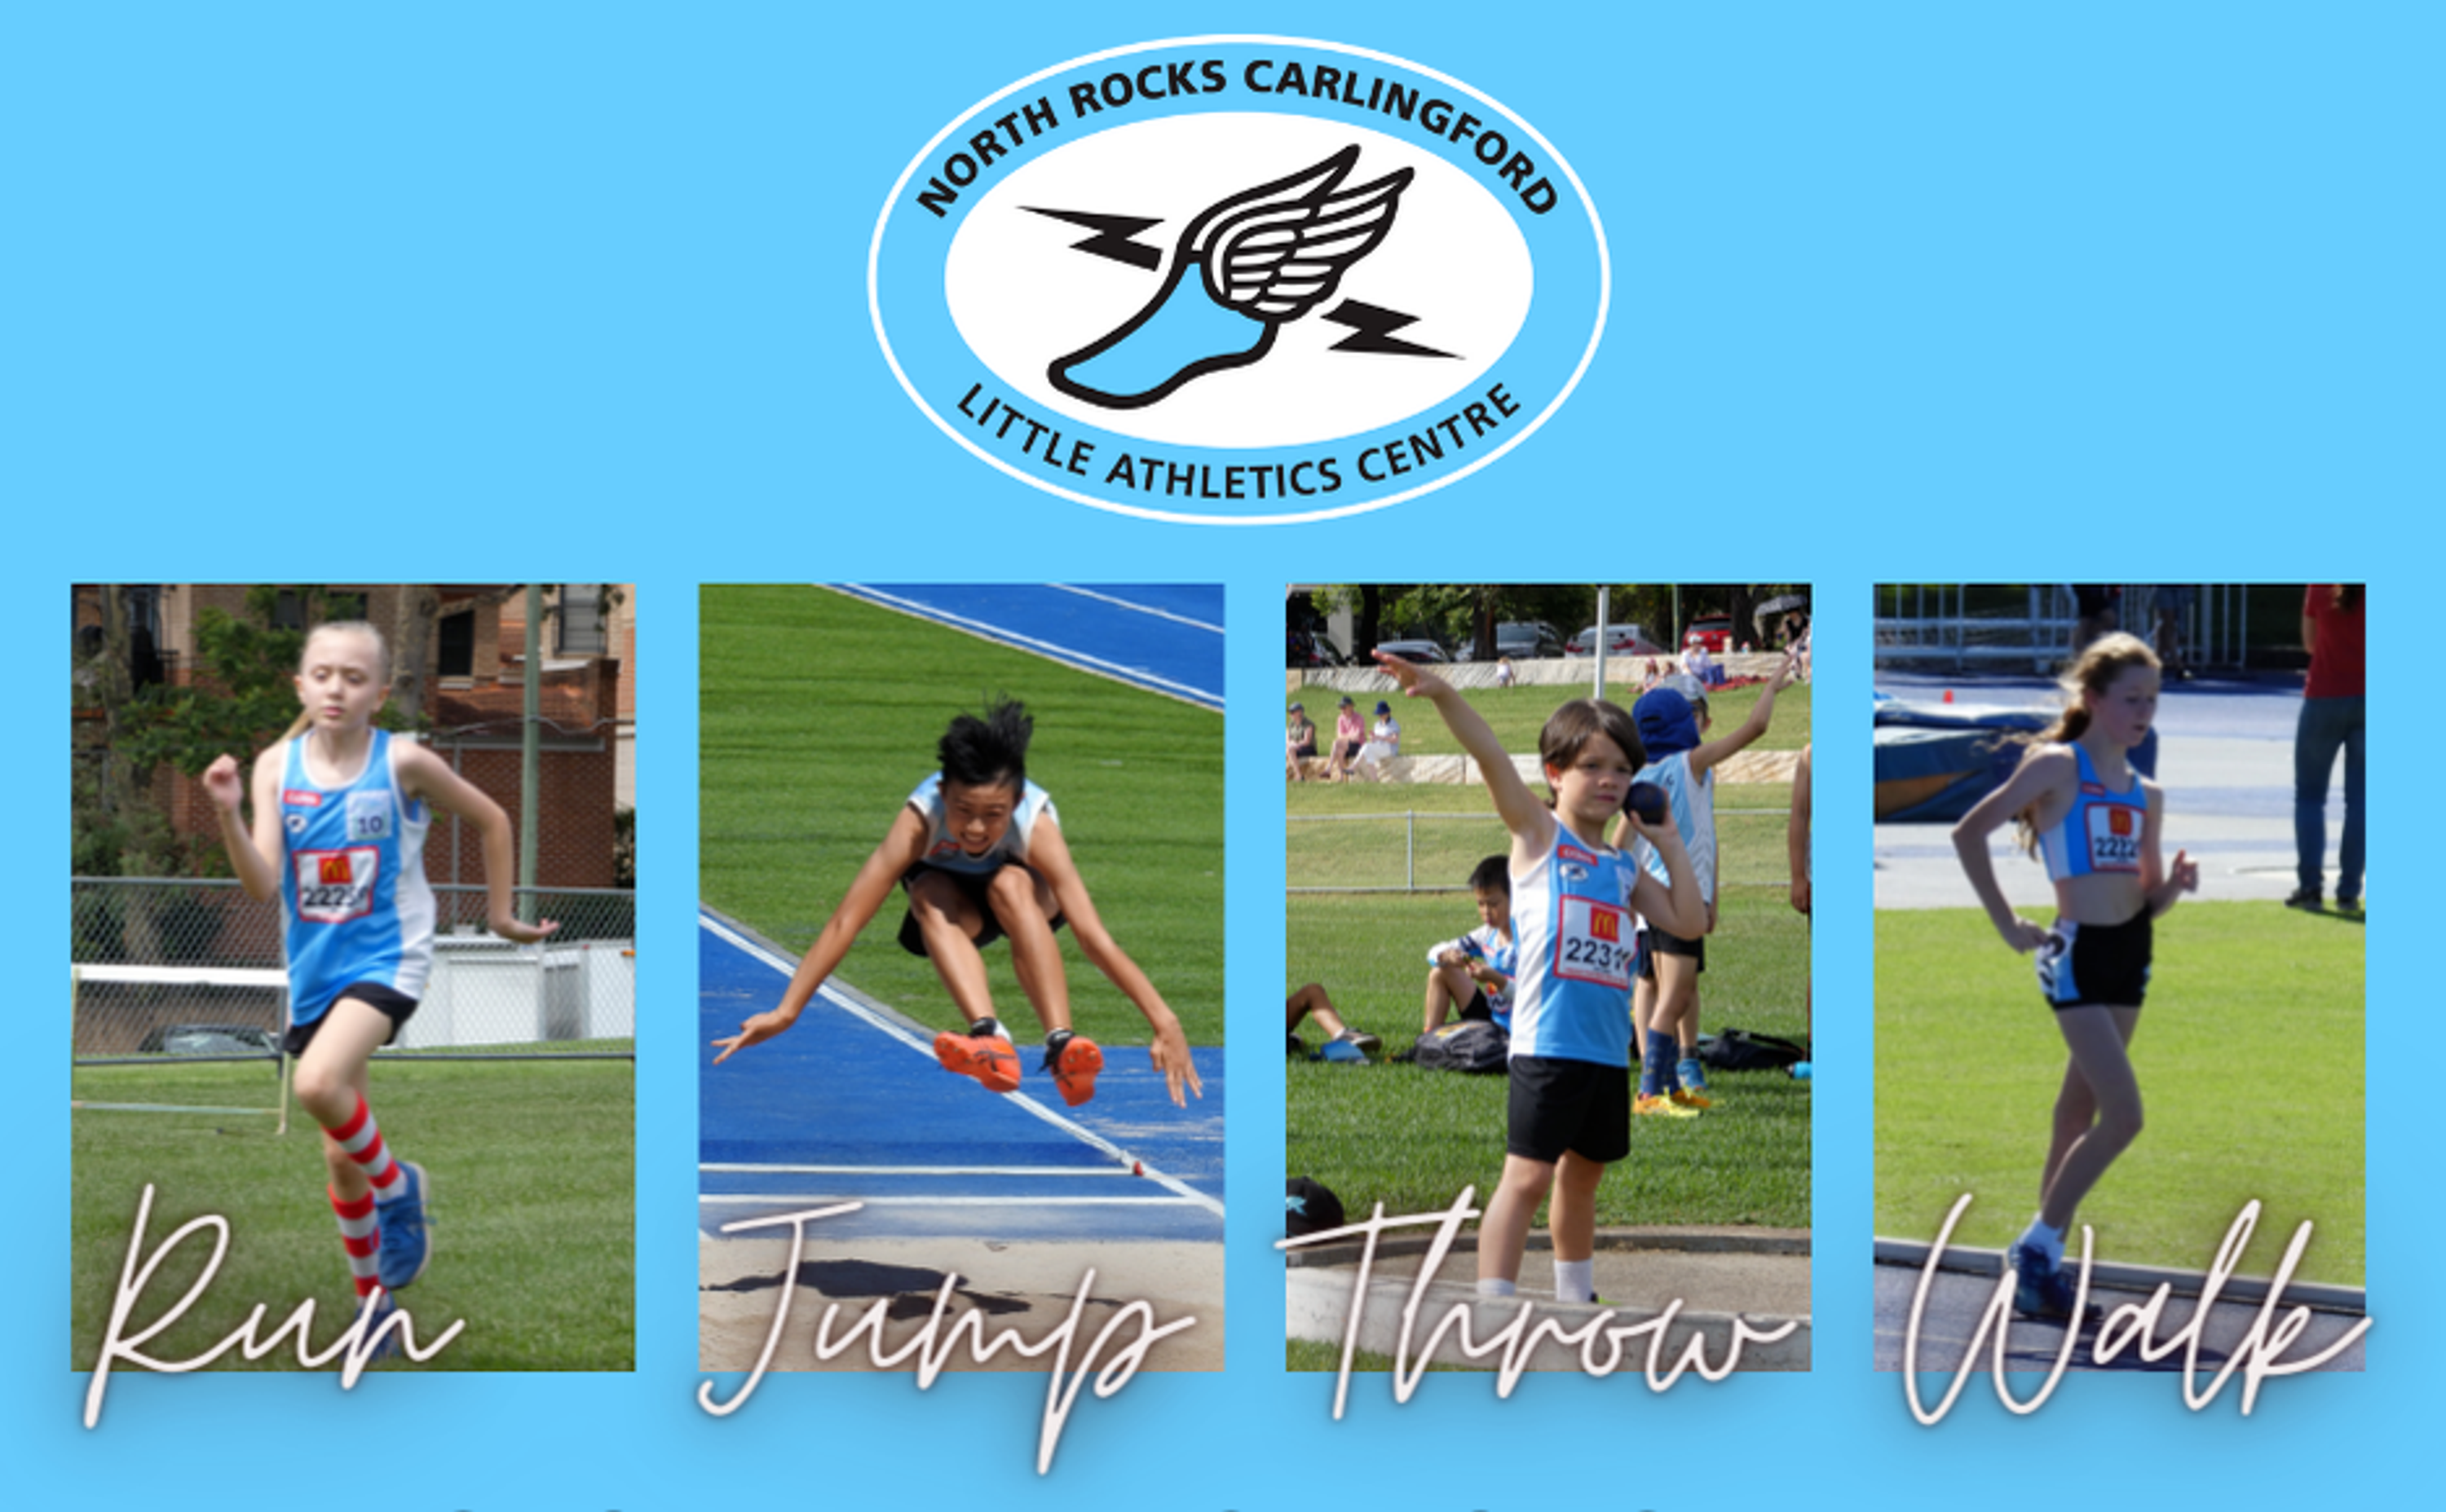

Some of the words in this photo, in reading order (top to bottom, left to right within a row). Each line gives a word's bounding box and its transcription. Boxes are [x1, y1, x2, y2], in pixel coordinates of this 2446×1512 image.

[916, 95, 1060, 218] NORTH
[1068, 60, 1227, 119] ROCKS
[1243, 60, 1558, 215] CARLINGFORD
[957, 382, 1096, 477] LITTLE
[1104, 453, 1342, 500] ATHLETICS
[1357, 381, 1521, 483] CENTRE
[359, 816, 384, 835] 10
